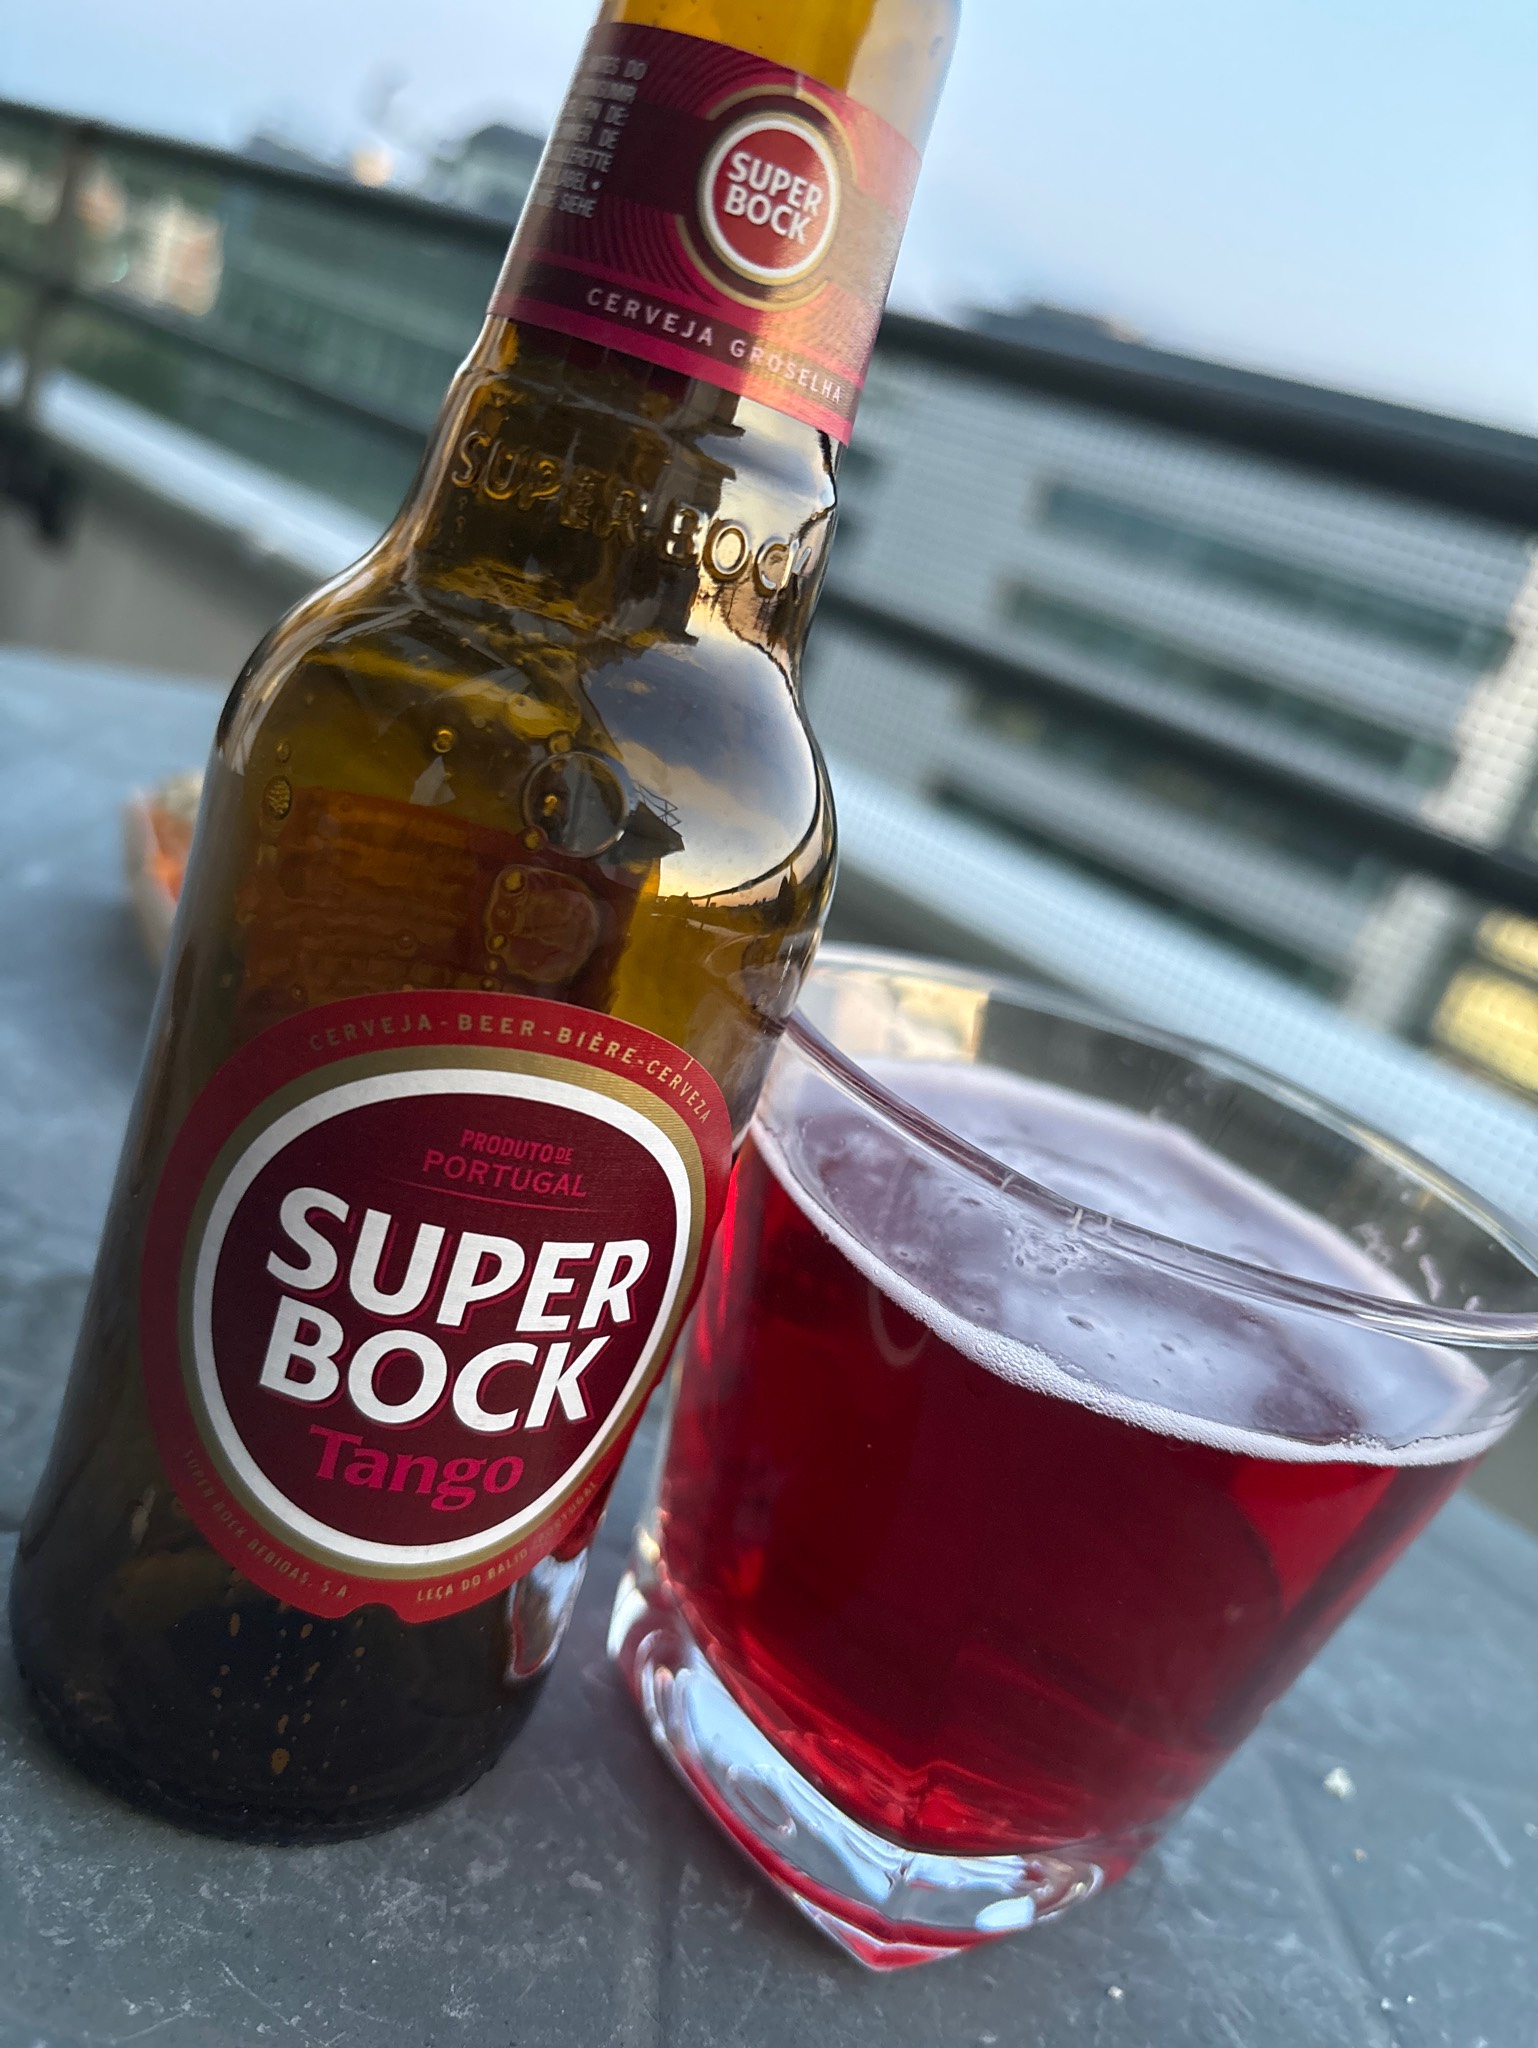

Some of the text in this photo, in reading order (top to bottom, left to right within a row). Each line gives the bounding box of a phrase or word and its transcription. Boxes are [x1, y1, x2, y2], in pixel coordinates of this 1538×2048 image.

[724, 184, 812, 245] BOCK
[728, 151, 824, 217] SUPER
[586, 288, 842, 402] CERVEJA GROSELHA
[451, 430, 639, 547] SUPER
[646, 1060, 711, 1124] CERVEZA
[422, 1148, 587, 1198] PORTUGAL
[460, 1128, 574, 1165] PRODUTO DE
[266, 1187, 649, 1332] SUPER
[259, 1296, 610, 1432] BOCK
[309, 1425, 524, 1512] Tango
[417, 1584, 453, 1601] LEÇA
[461, 1574, 481, 1592] DO
